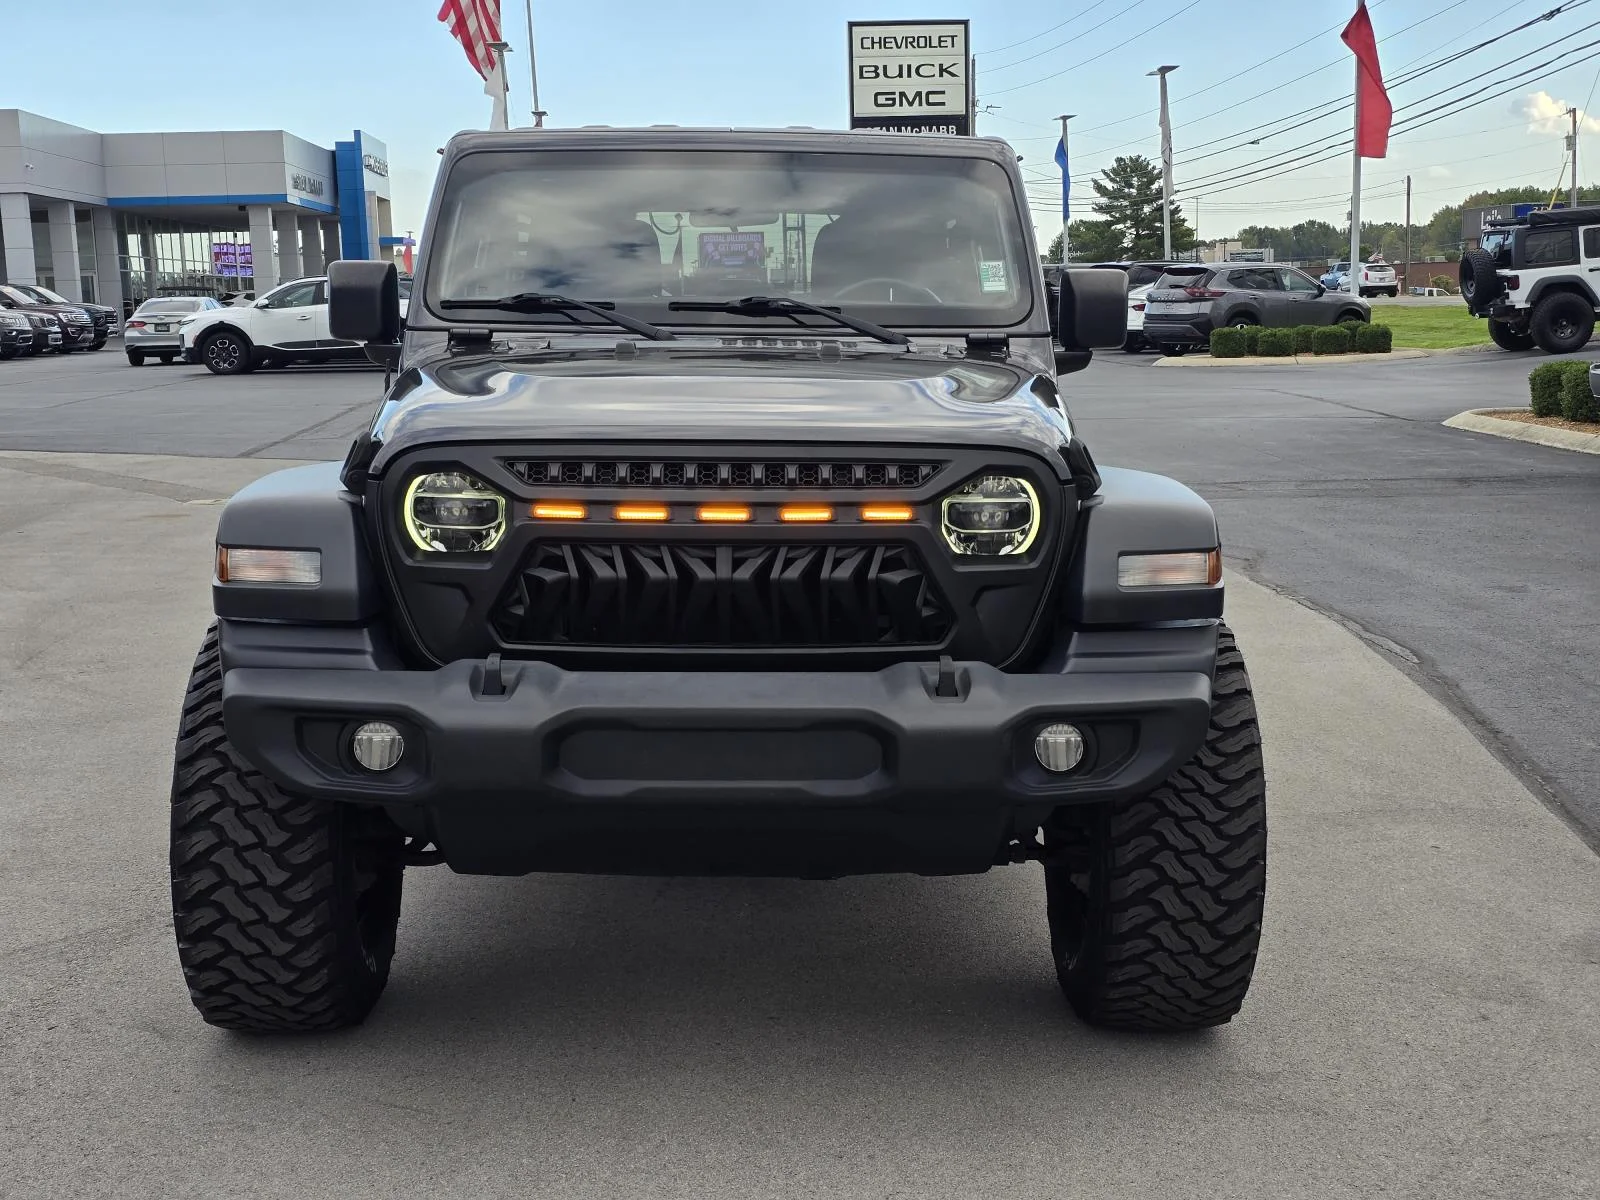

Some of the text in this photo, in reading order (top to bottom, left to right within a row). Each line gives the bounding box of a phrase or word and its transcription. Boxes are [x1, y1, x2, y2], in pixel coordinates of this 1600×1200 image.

[860, 35, 958, 49] CHEVROLET
[859, 63, 960, 79] BUICK
[873, 90, 946, 107] GMC
